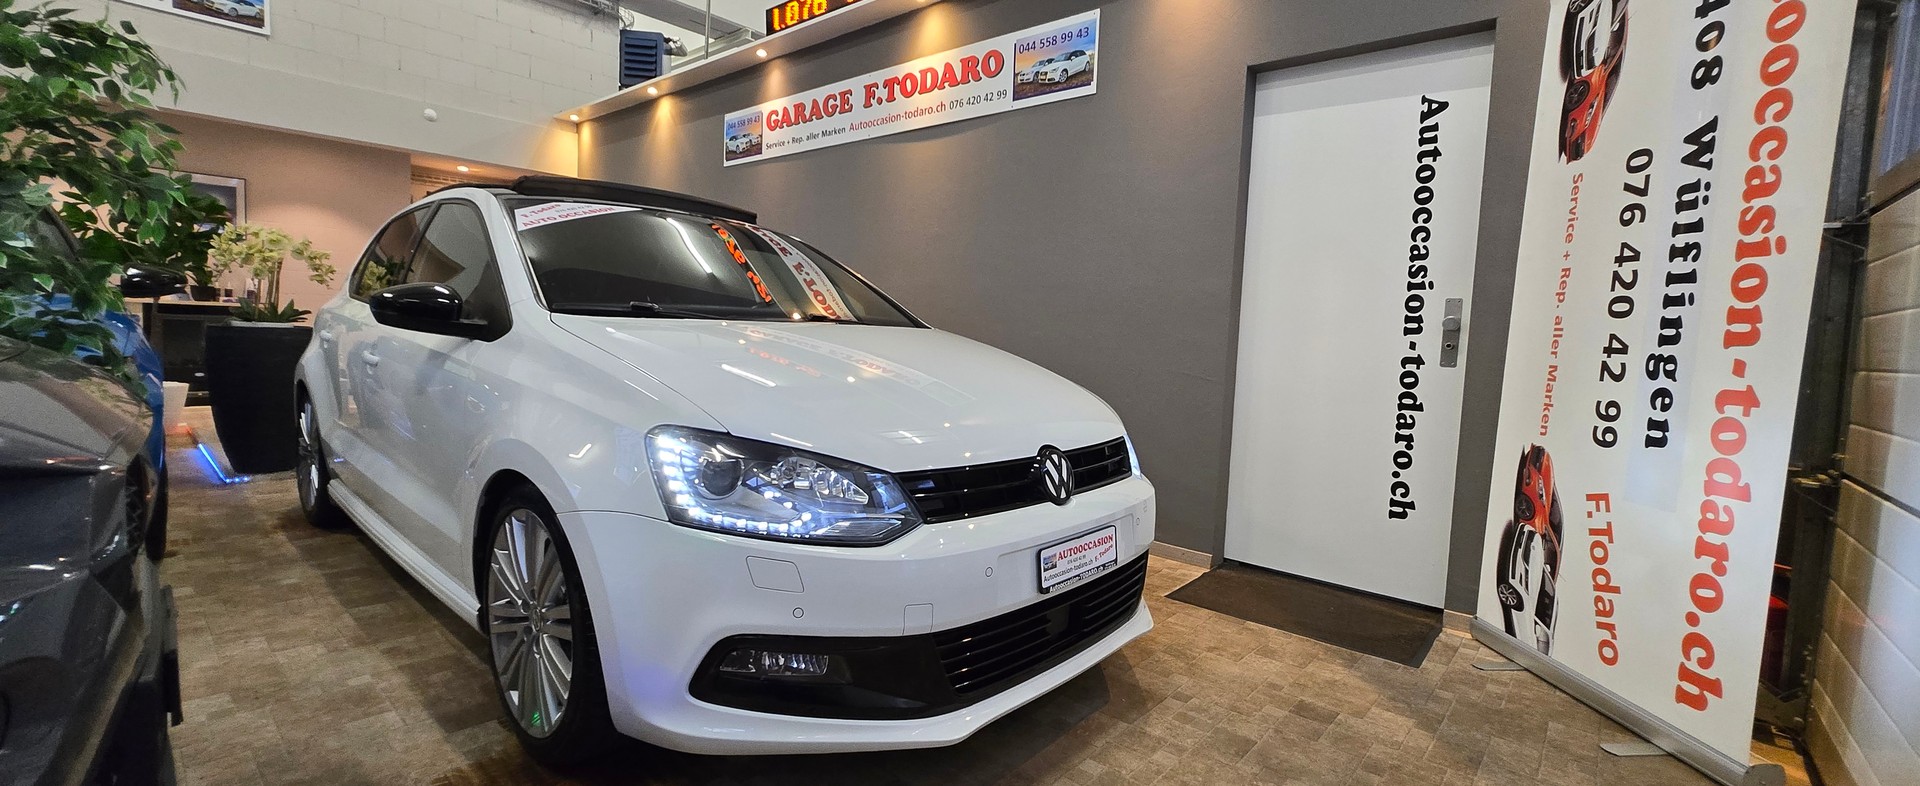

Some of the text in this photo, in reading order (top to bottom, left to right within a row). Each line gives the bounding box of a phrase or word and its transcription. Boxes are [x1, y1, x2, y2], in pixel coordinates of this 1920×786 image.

[766, 49, 1004, 132] GARAGE F.TODARO
[1018, 26, 1090, 54] 044 558 99 43
[765, 139, 786, 150] Service
[792, 135, 805, 145] Rep.
[805, 131, 820, 142] aller
[821, 126, 846, 139] Marken
[849, 88, 1008, 132] Autooccasion-todaro.ch 076 420 42 99
[522, 207, 616, 228] AUTO OCCASION
[1645, 115, 1719, 448] Wülflingen
[1388, 95, 1450, 519] Autooccasion-todaro.ch
[1539, 172, 1583, 436] Service + Rep. aller Marken
[1592, 148, 1654, 448] 076 420 42 99
[1675, 0, 1807, 711] ooccasion-todaro.ch
[1057, 533, 1114, 561] AUTOOCCASION
[1585, 493, 1622, 667] F.Todaro
